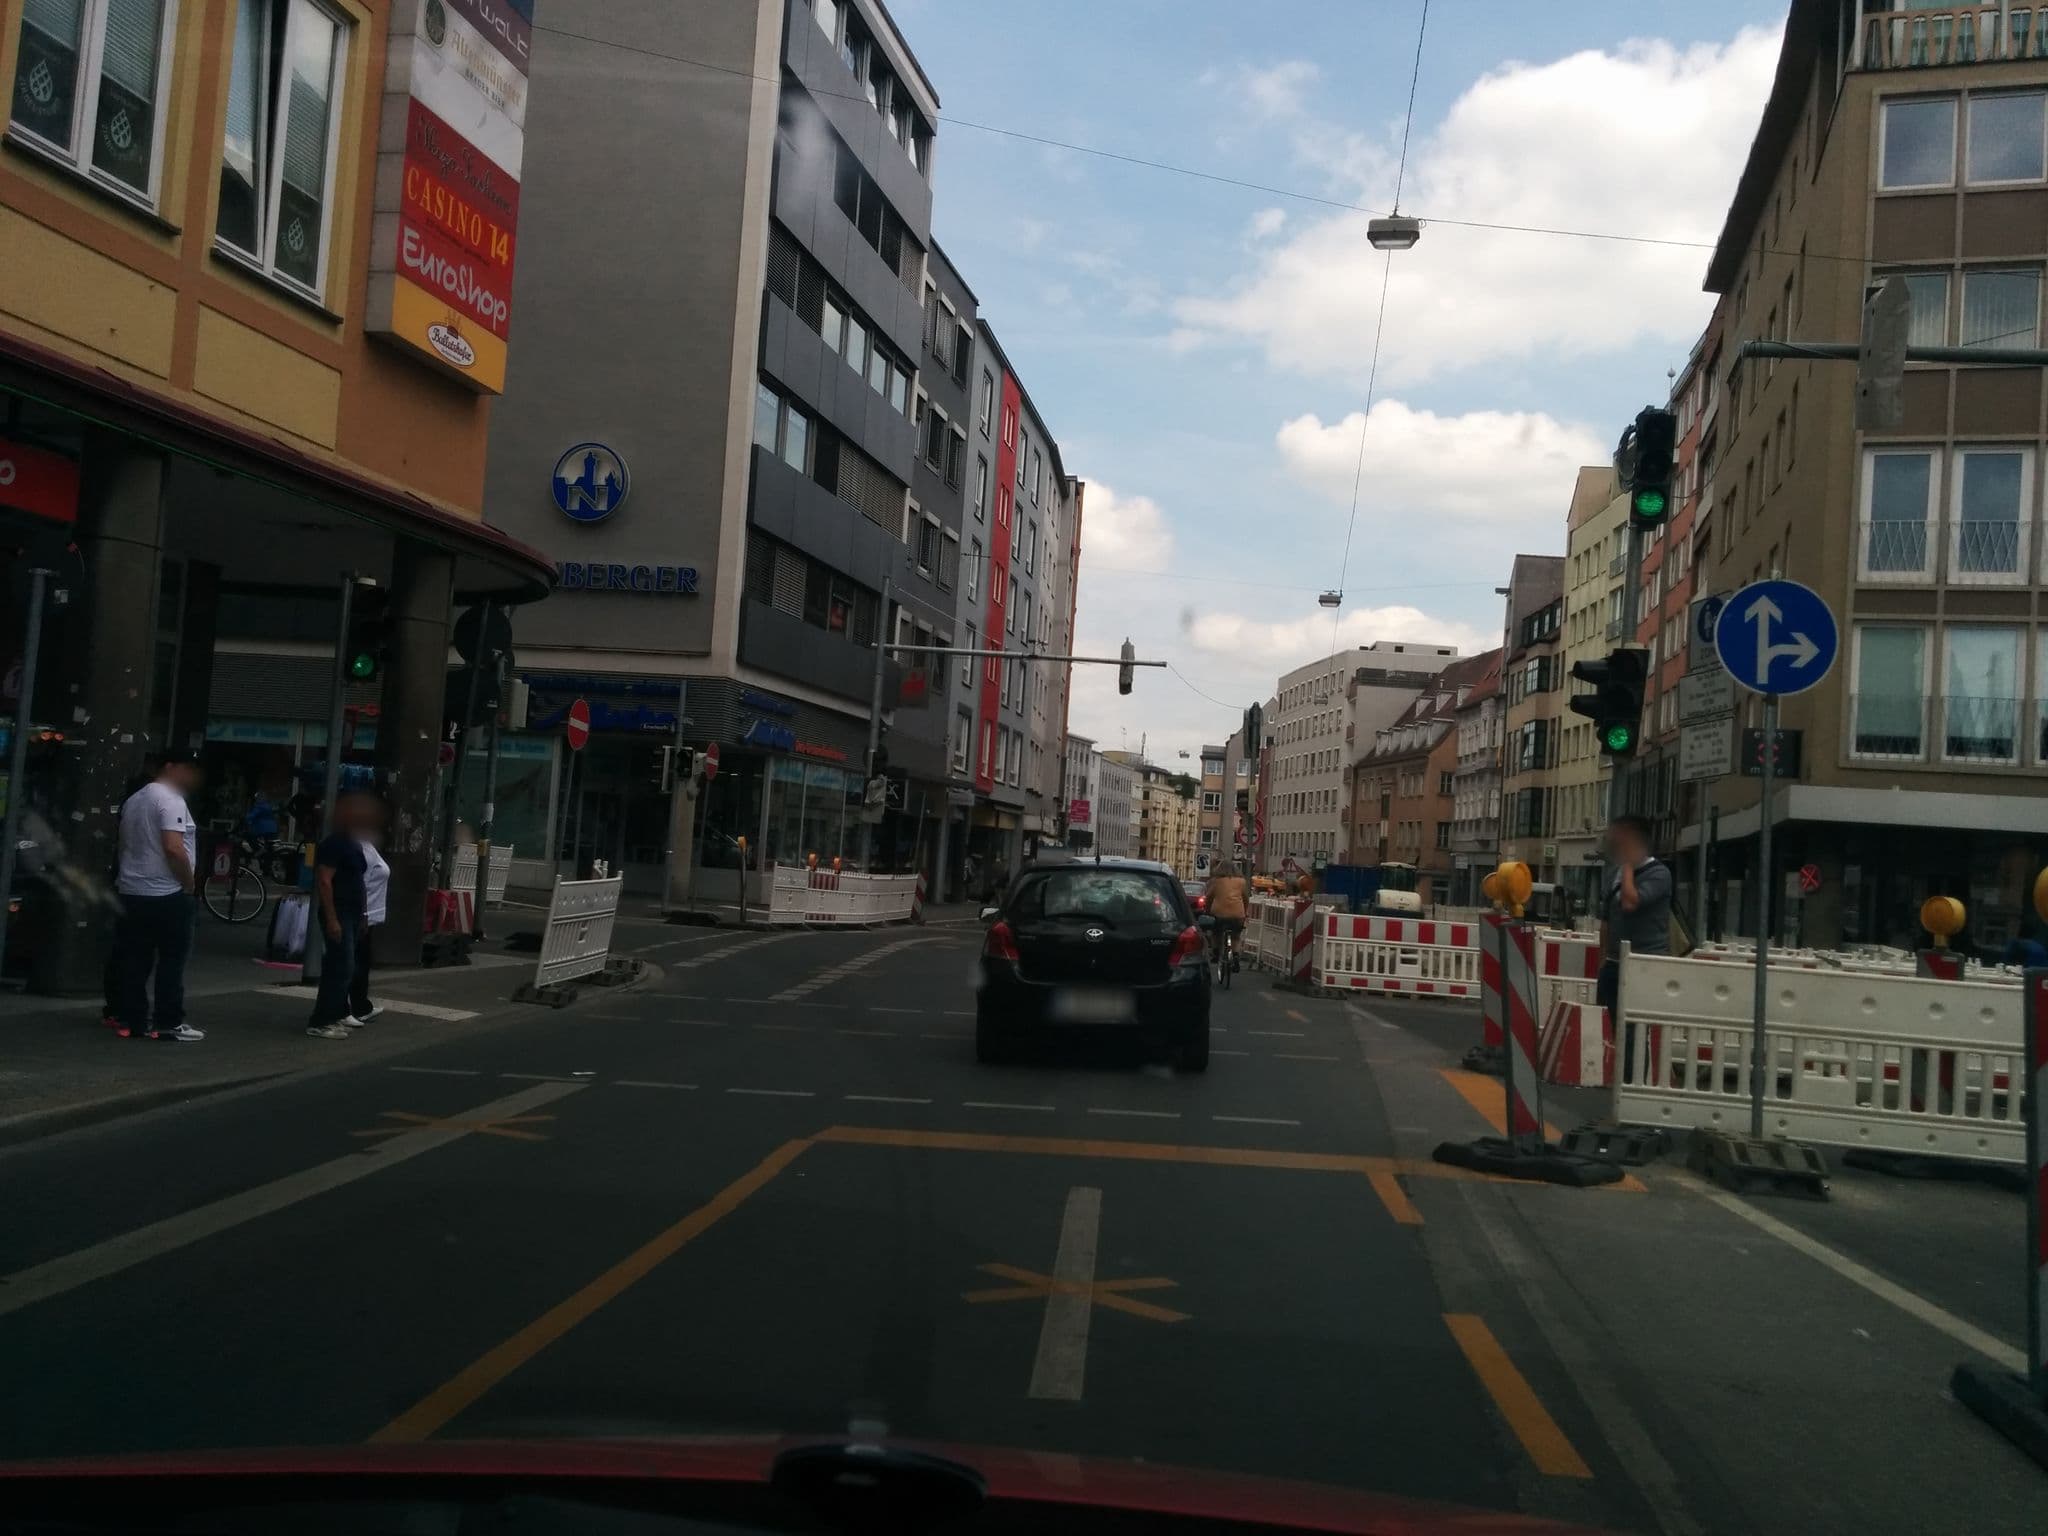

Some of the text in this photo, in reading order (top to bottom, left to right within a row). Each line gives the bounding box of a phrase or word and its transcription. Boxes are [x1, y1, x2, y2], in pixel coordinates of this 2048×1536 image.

[407, 167, 481, 247] CASINO
[488, 223, 509, 266] 14
[403, 227, 507, 330] EuroShop
[566, 485, 609, 512] N
